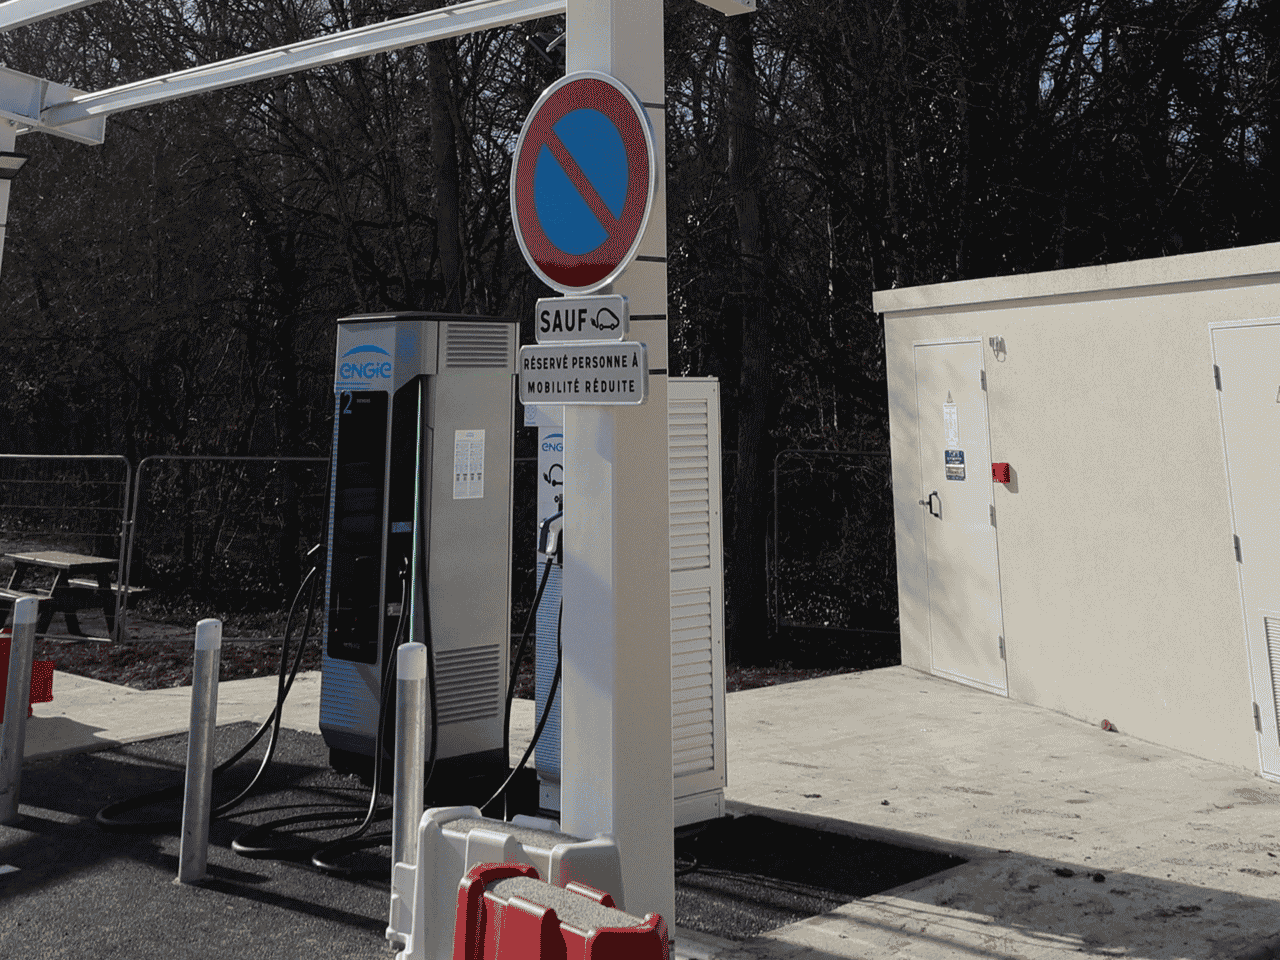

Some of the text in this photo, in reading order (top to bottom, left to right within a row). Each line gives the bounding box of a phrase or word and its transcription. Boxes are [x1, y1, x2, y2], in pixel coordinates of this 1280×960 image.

[540, 308, 587, 333] SAUF
[523, 352, 638, 370] RÉSERVÉ PERSONNE À
[527, 378, 635, 394] MOBILITÉ RÉDUITE
